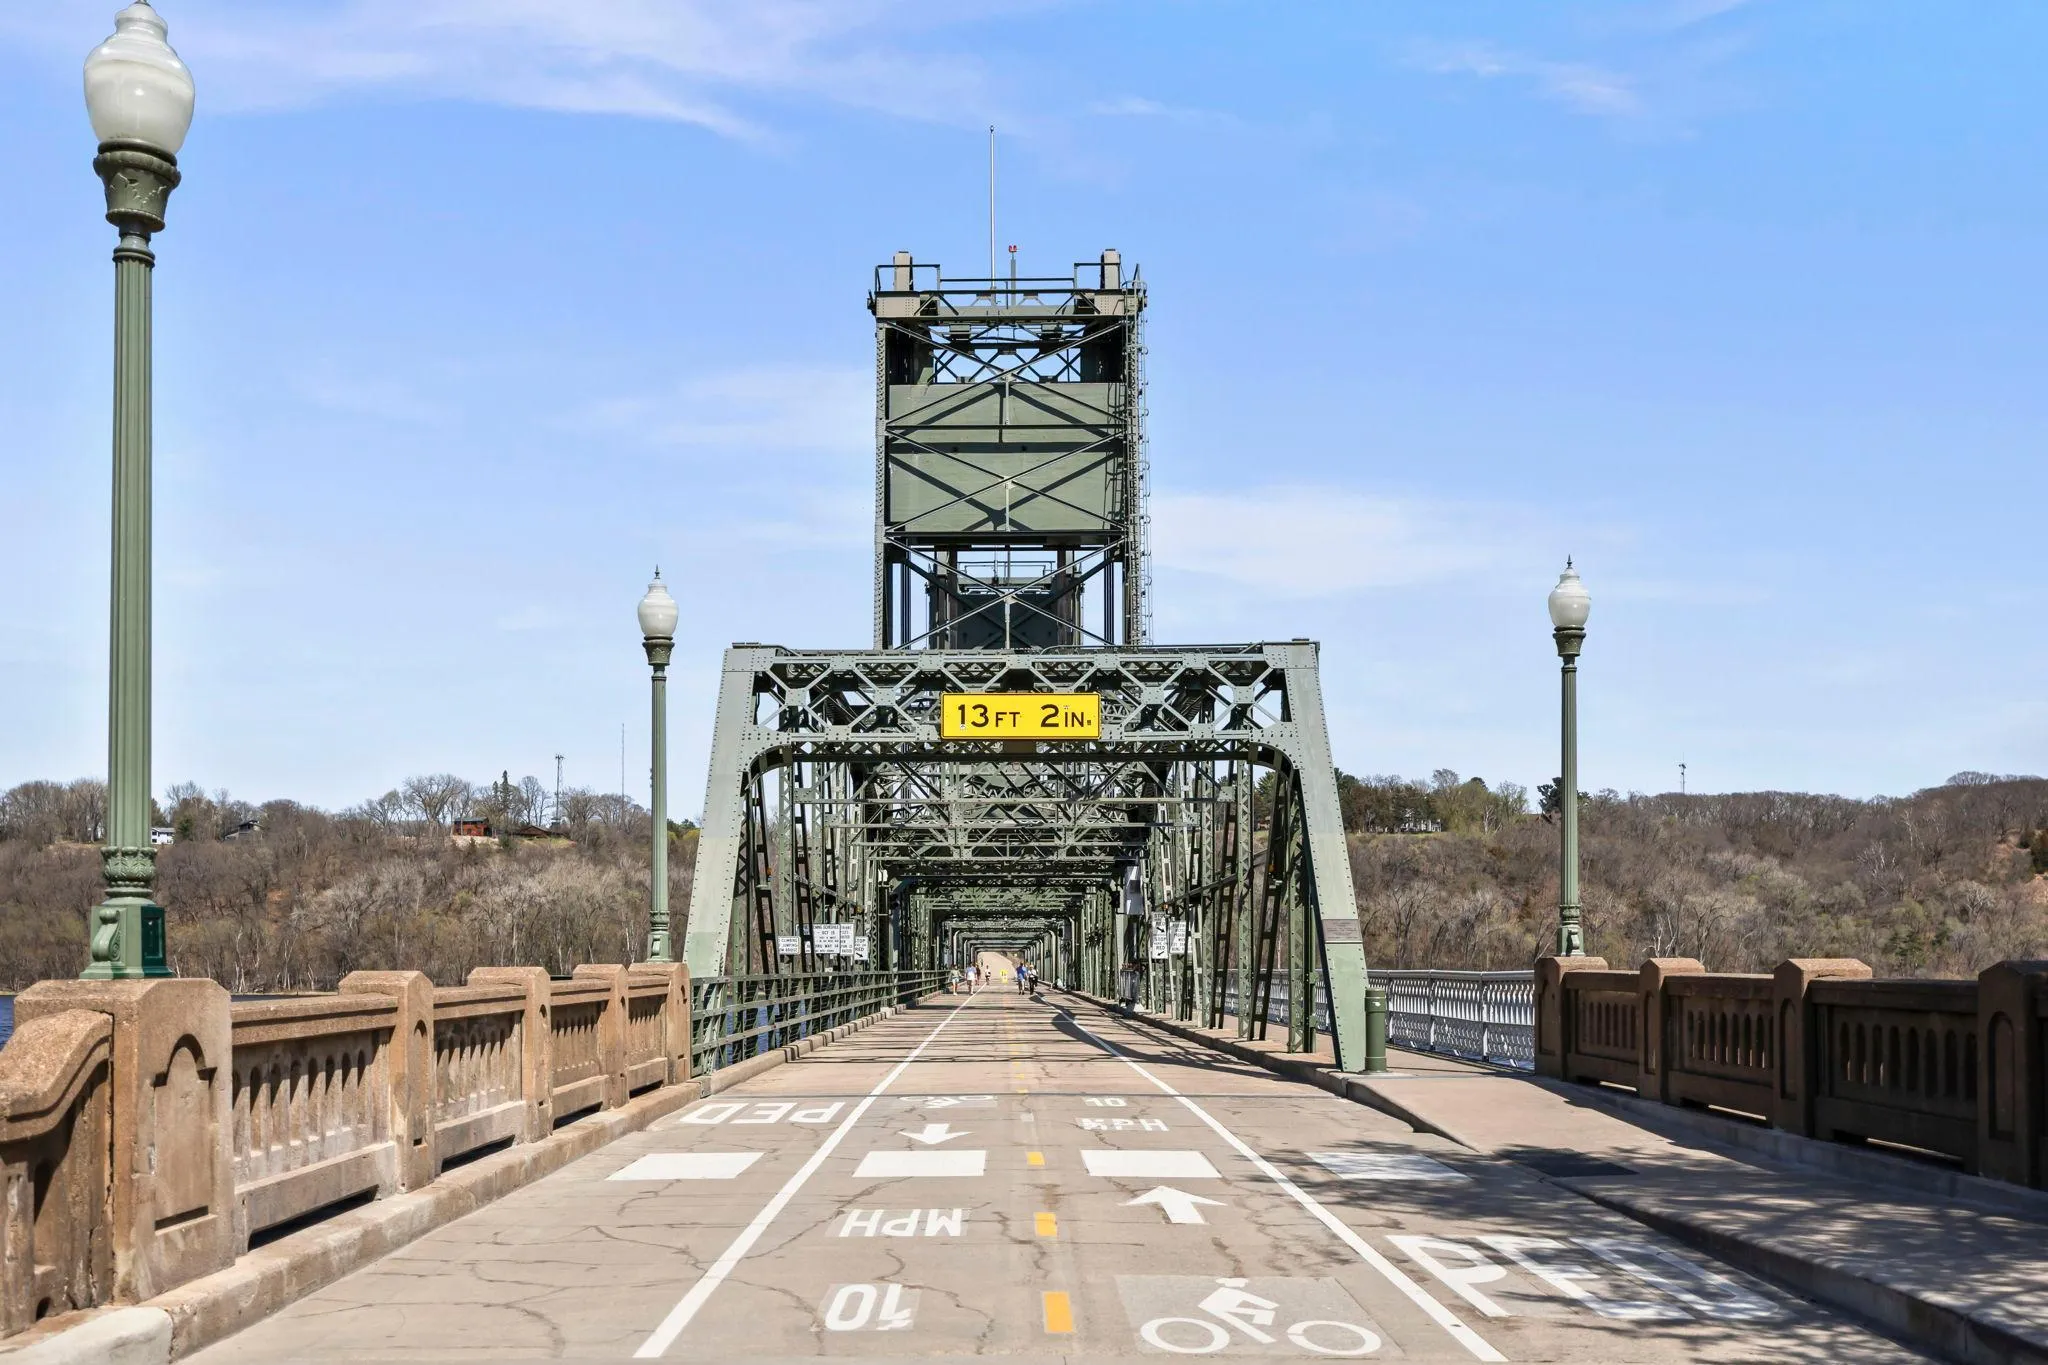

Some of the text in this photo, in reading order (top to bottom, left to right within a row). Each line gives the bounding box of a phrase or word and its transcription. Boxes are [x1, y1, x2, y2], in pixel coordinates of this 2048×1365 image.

[681, 1101, 846, 1124] PED
[838, 1209, 964, 1237] MPH
[1386, 1235, 1780, 1319] PED
[824, 1283, 913, 1331] 10
